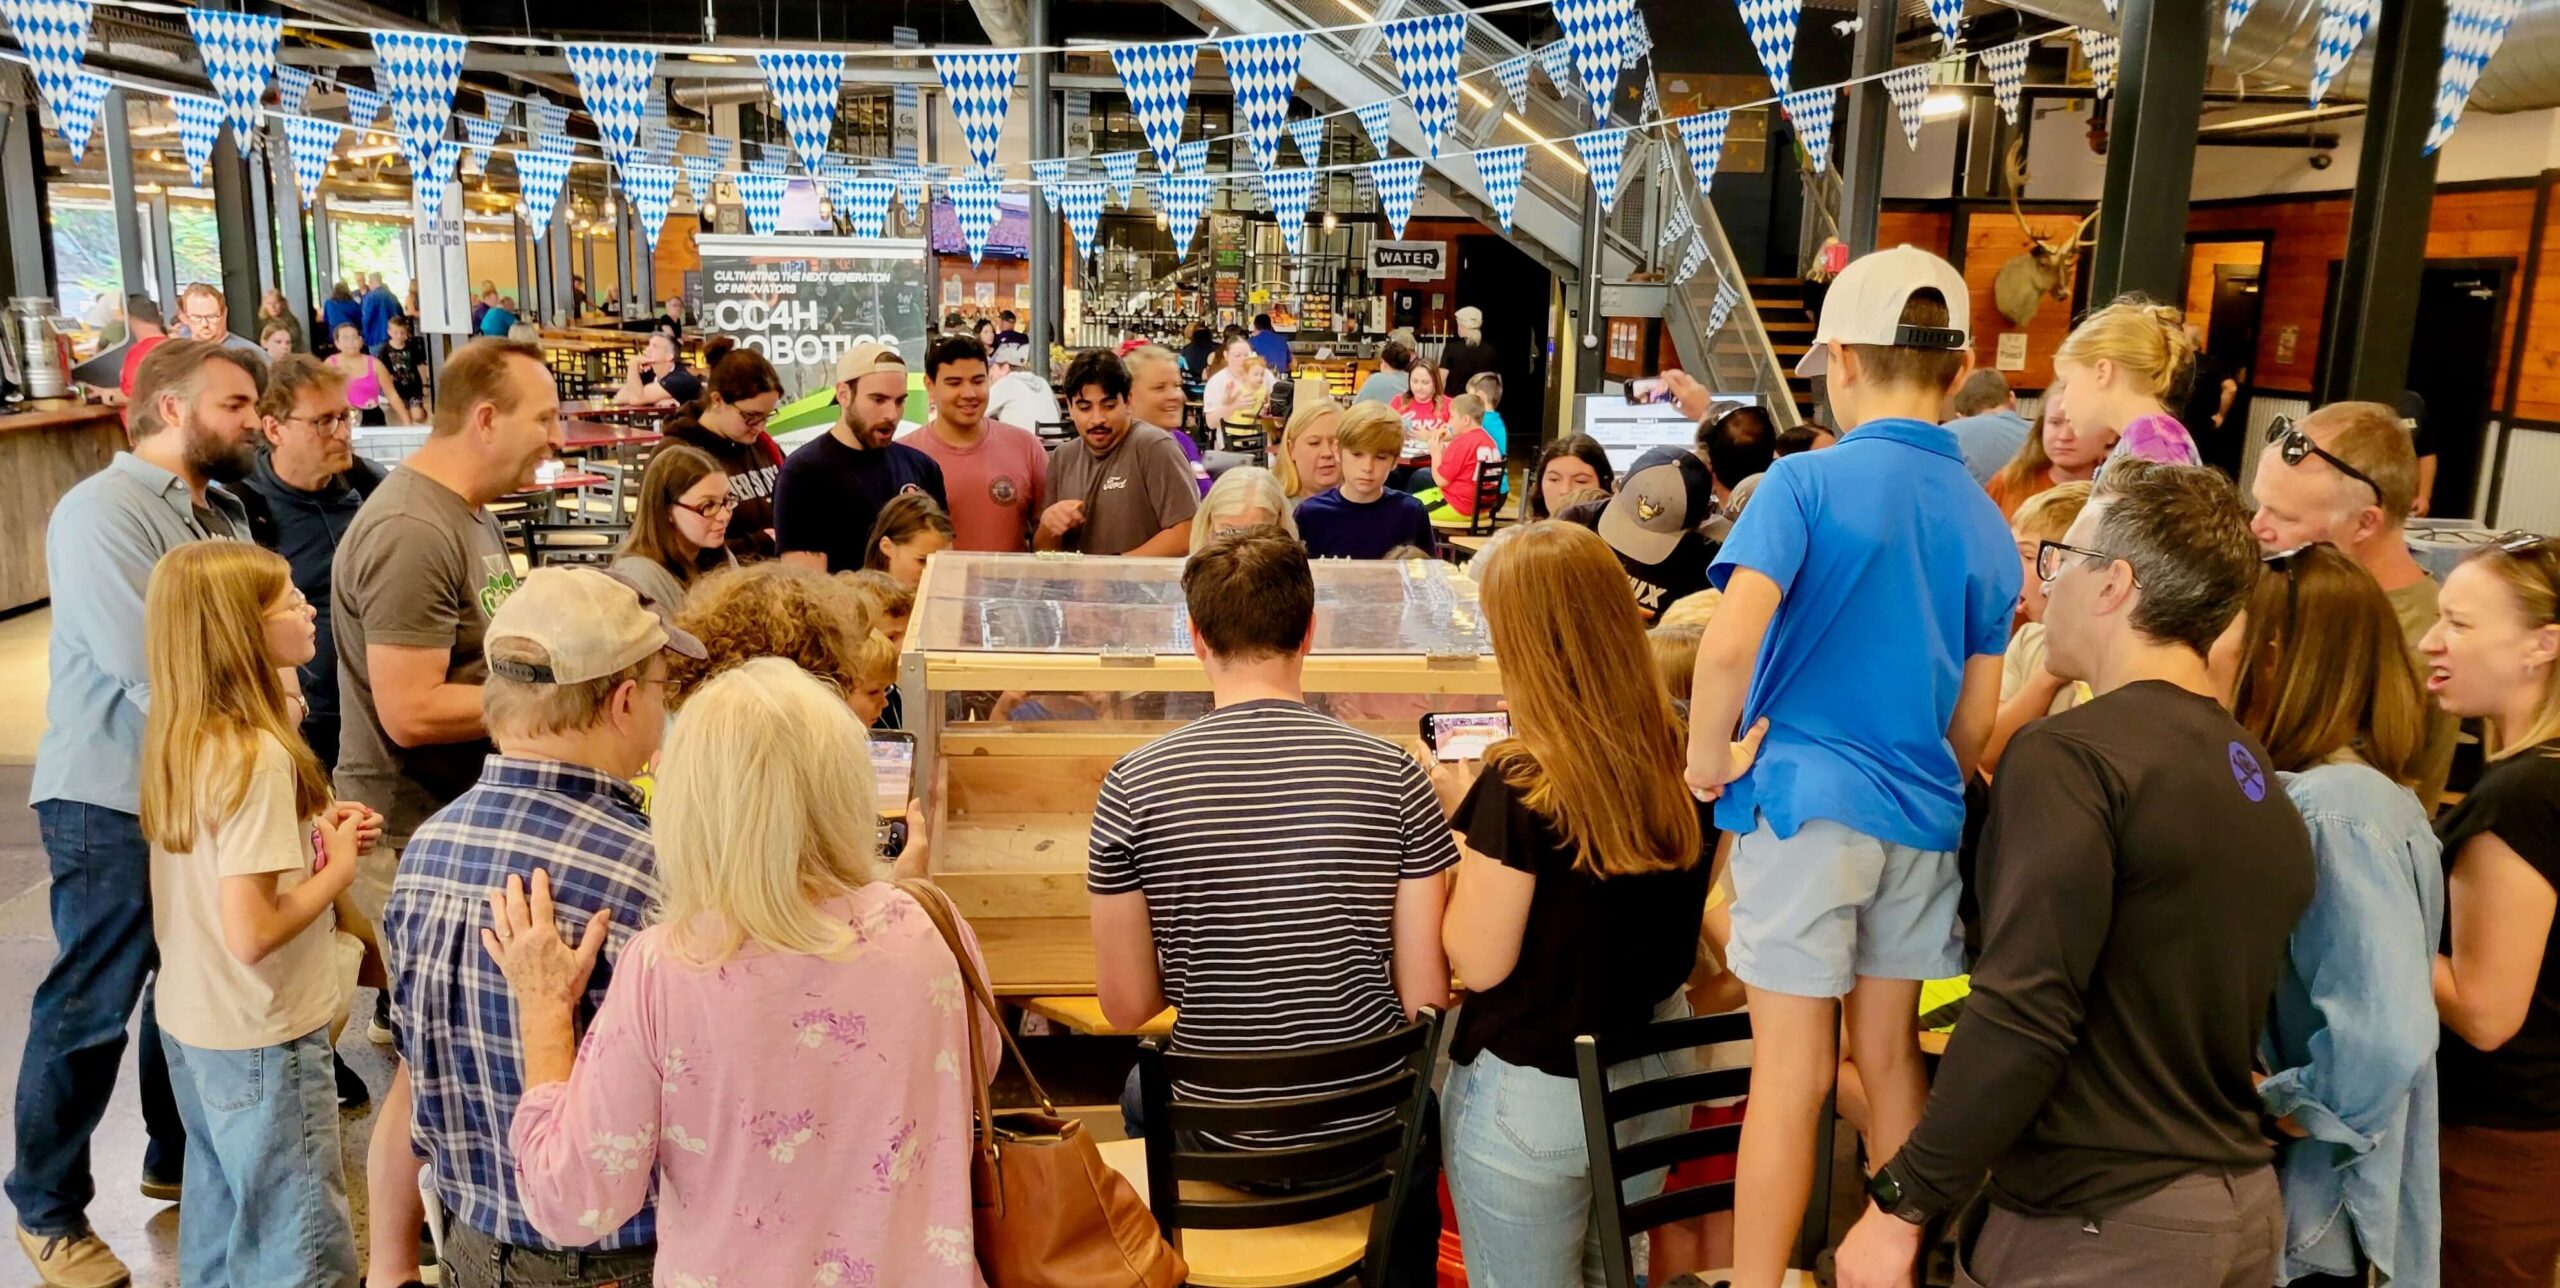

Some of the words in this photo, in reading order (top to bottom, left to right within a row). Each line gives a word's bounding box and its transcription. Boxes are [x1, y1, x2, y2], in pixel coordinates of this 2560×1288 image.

[1380, 252, 1434, 265] WATER
[714, 271, 780, 282] CULTIVATING
[781, 272, 801, 282] THE
[802, 272, 828, 282] NEXT
[829, 272, 891, 283] GENERATION
[714, 283, 731, 294] OF
[731, 284, 797, 294] INNOVATORS
[715, 299, 819, 332] CC4H
[732, 334, 901, 365] OBOTIS
[1103, 476, 1128, 491] Ford
